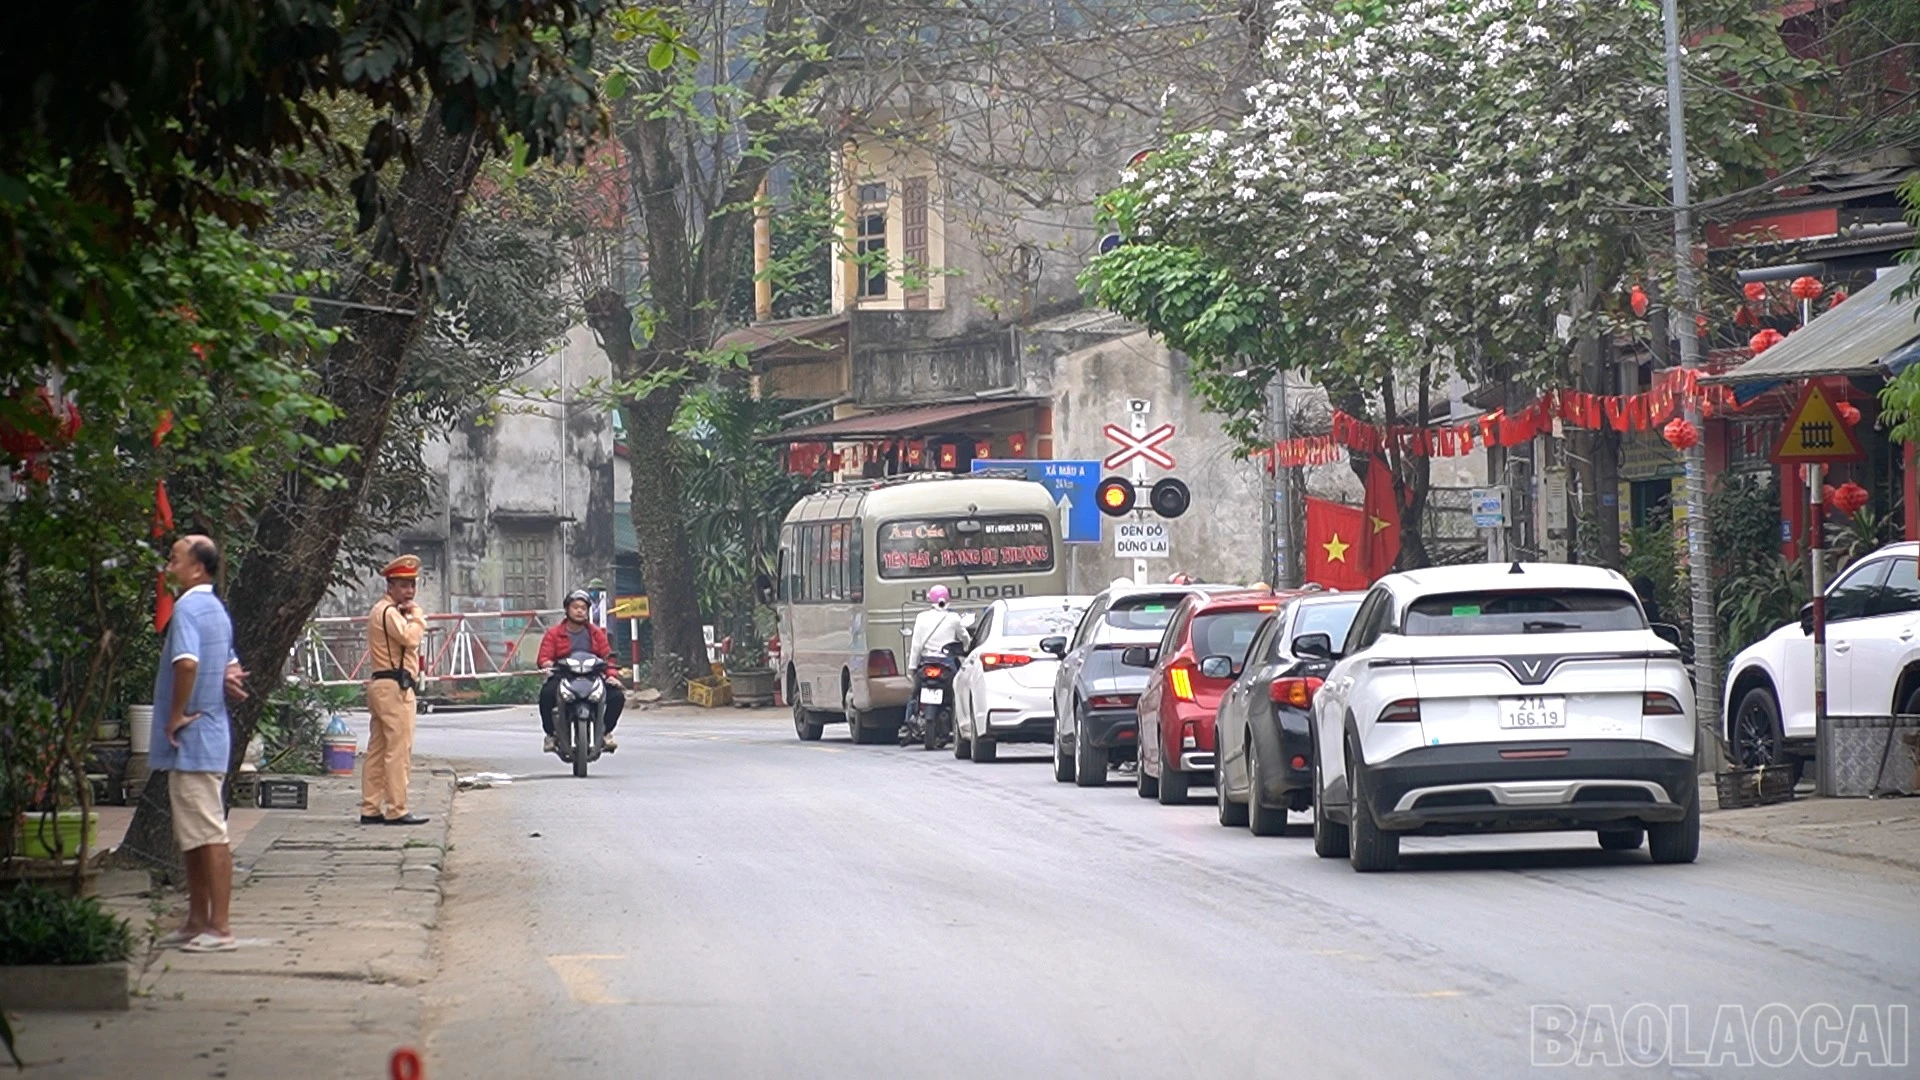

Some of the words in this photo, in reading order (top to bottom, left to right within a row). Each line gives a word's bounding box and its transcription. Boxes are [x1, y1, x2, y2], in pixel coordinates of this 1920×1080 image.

[1079, 466, 1085, 476] A
[911, 583, 1024, 602] HUNDAI
[1519, 697, 1546, 711] 21A
[1509, 711, 1559, 727] 166.19
